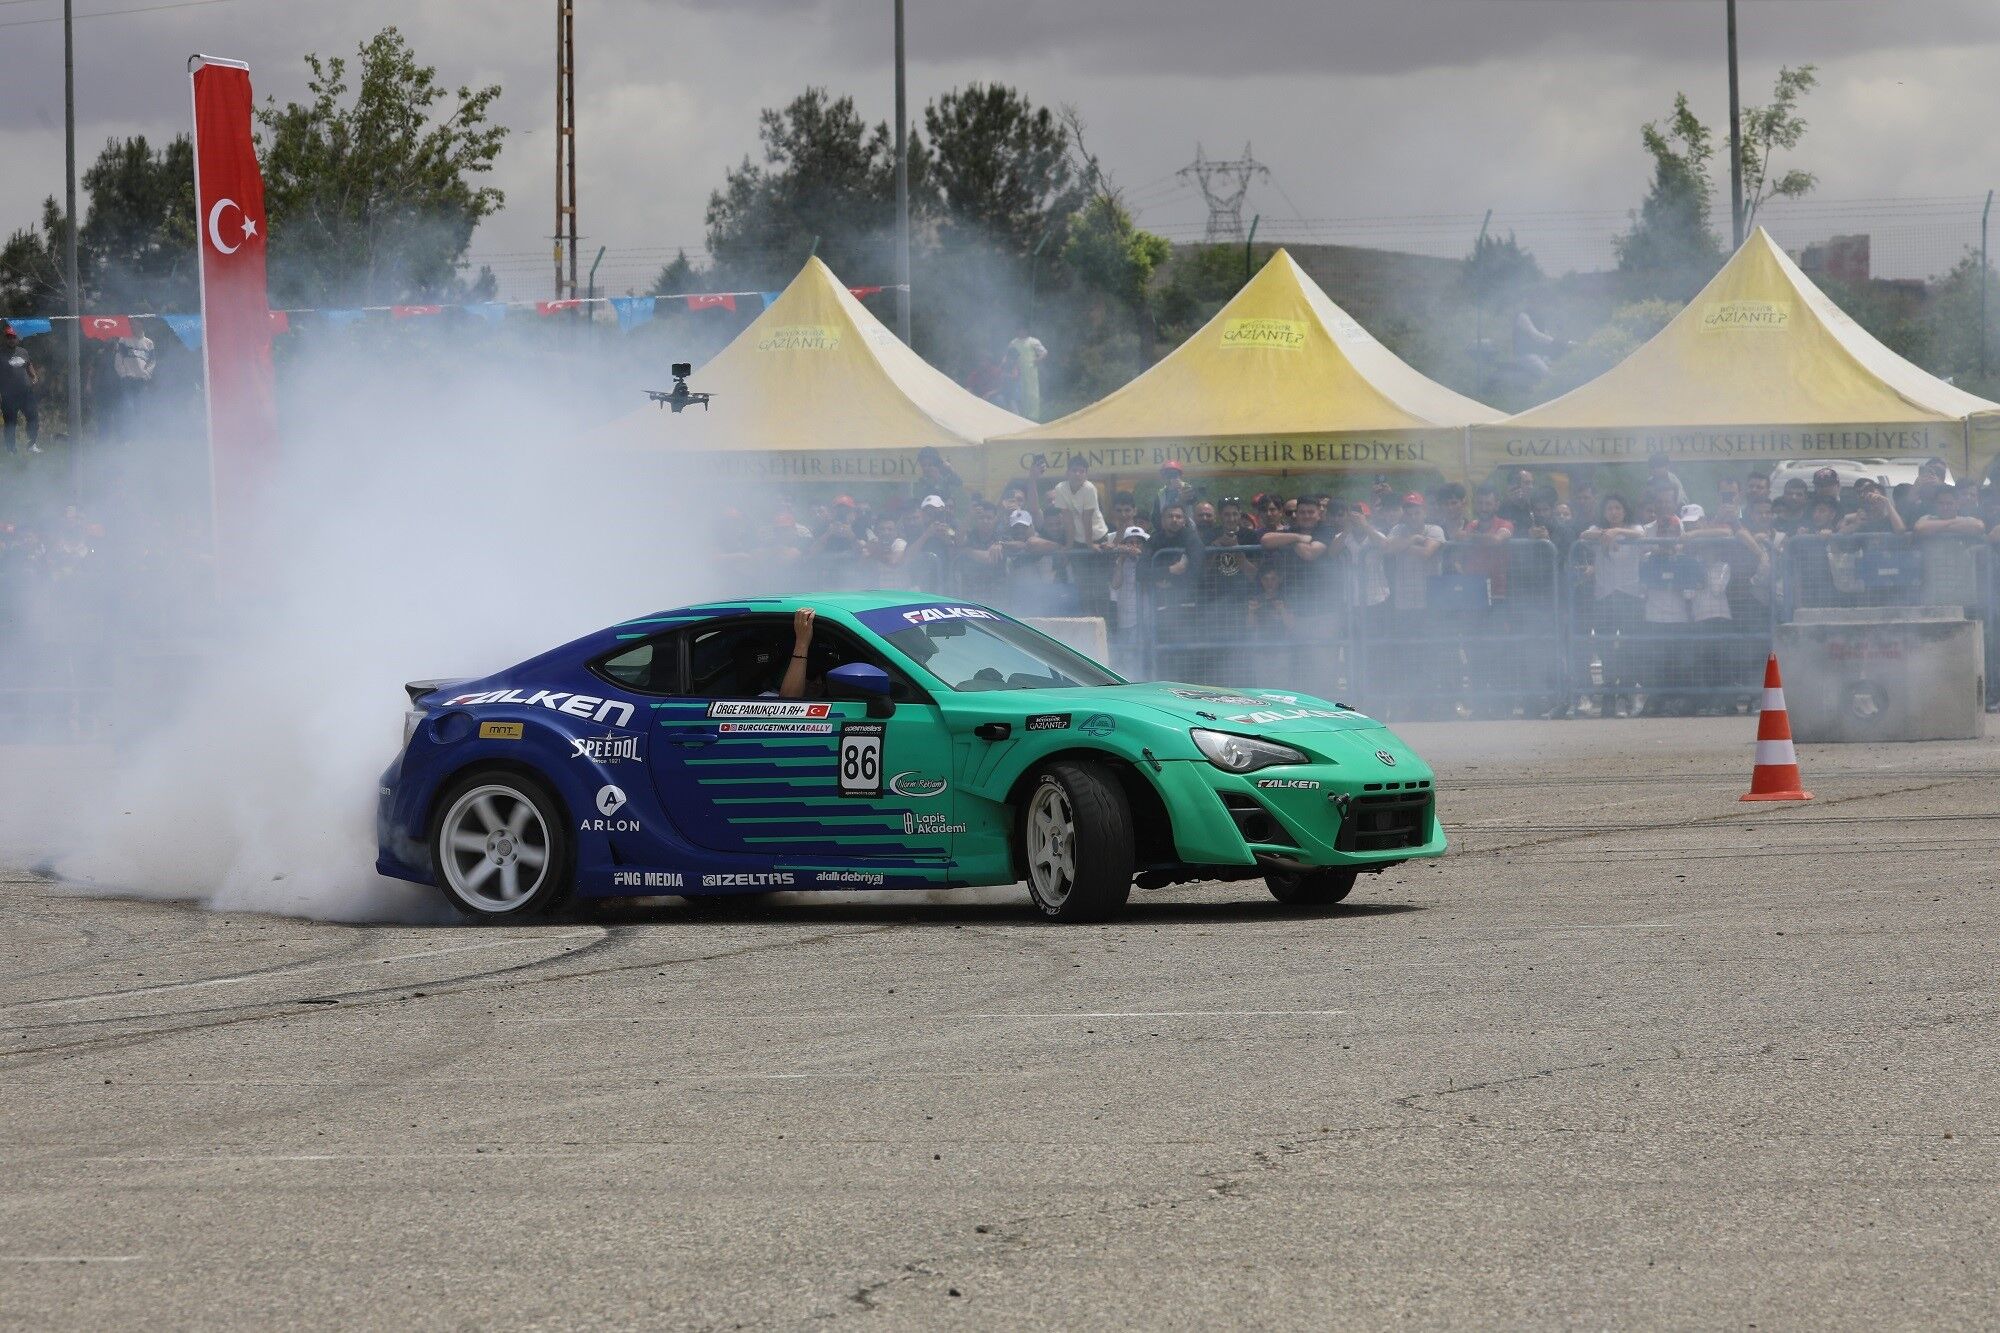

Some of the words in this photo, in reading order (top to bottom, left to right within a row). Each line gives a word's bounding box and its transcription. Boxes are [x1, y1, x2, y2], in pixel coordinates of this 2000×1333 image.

[1506, 436, 1638, 457] GAZİANTEP
[1801, 427, 1930, 450] BELEDİYESİ
[1153, 441, 1296, 467] BÜYÜKŞEHİR
[1303, 440, 1425, 461] BELEDİYESİ
[903, 607, 1000, 624] FALKEN
[442, 689, 635, 728] FALKEN
[716, 703, 739, 715] ÖRGE
[740, 705, 780, 717] PAMUKÇU
[780, 706, 787, 715] A
[571, 737, 643, 762] SPEEDOL
[844, 745, 877, 780] 86
[1257, 779, 1320, 790] FALKEN
[580, 819, 640, 832] ARLON
[916, 812, 946, 826] Lapis
[917, 823, 967, 834] Akademi
[645, 872, 684, 887] MEDIA
[840, 872, 885, 886] debriyaj
